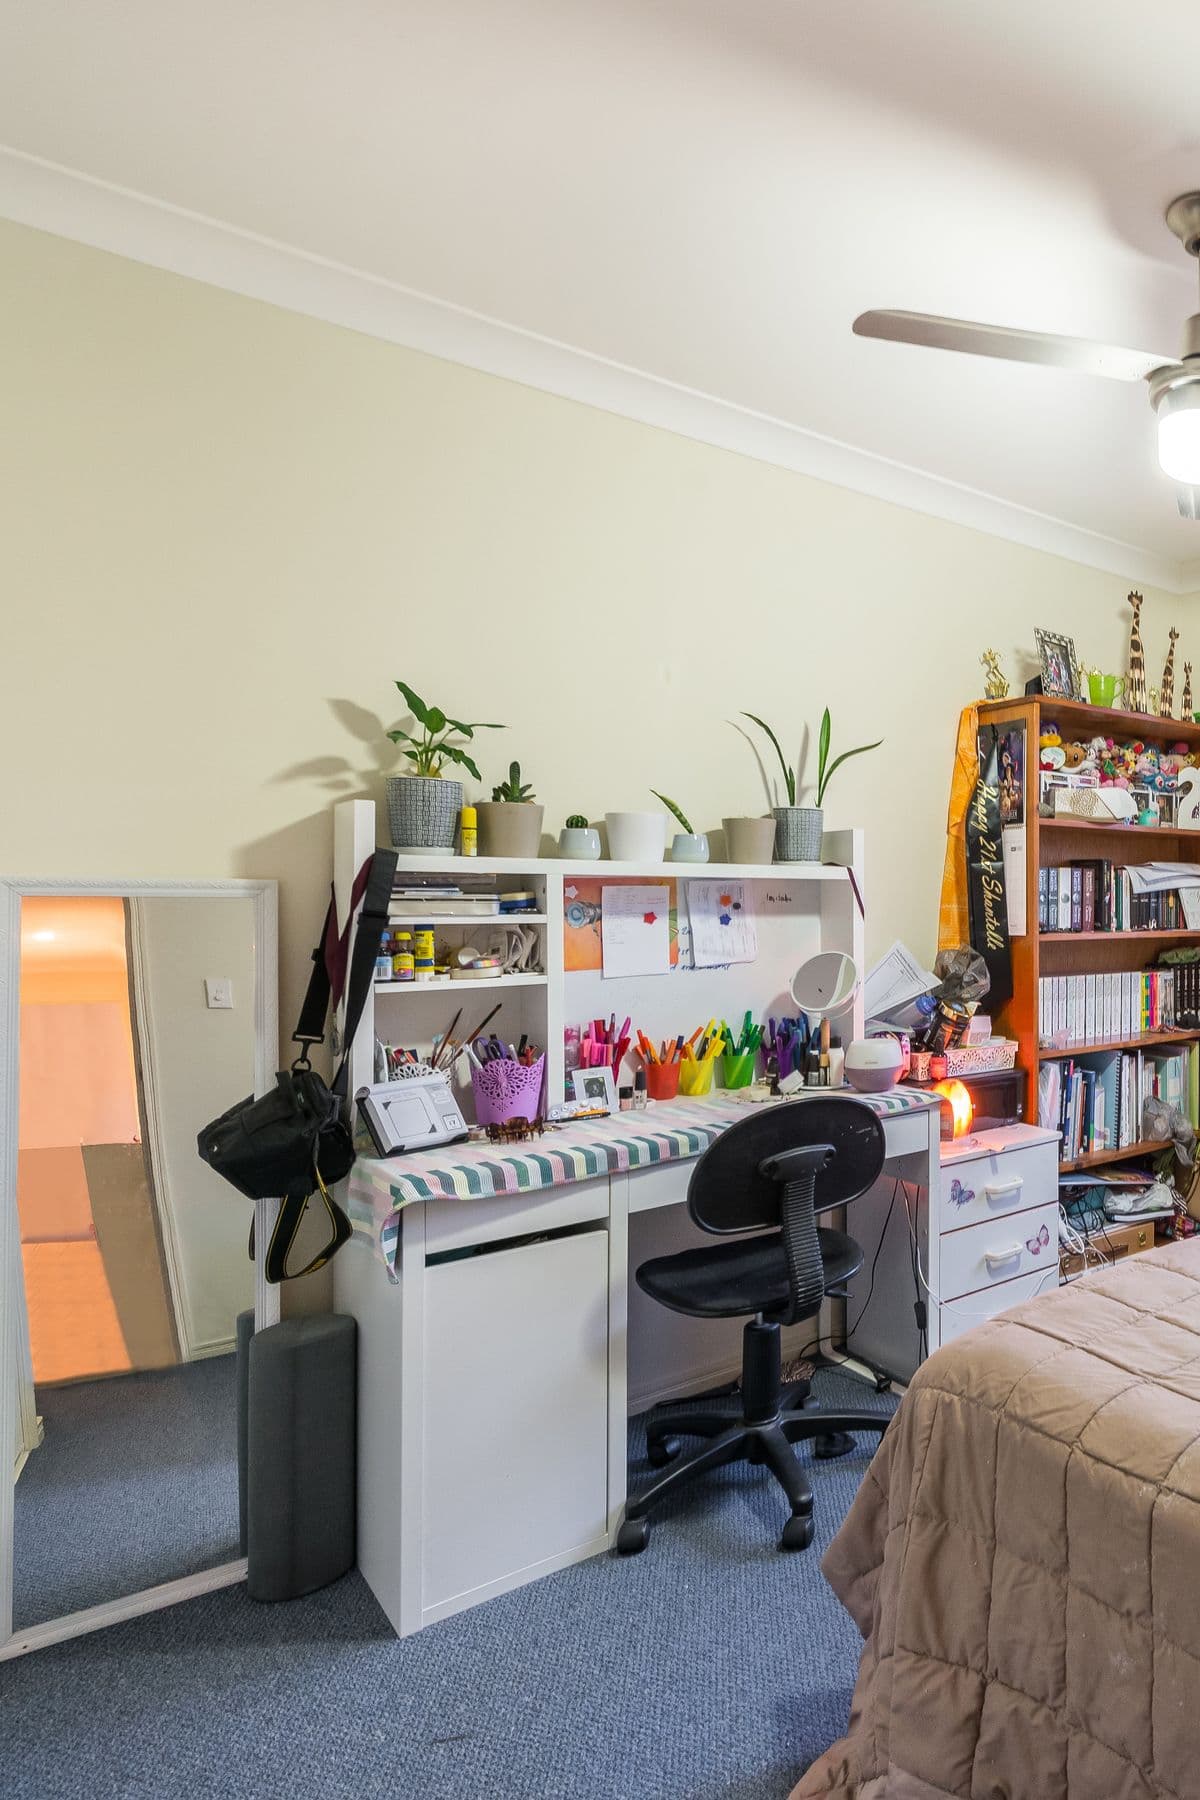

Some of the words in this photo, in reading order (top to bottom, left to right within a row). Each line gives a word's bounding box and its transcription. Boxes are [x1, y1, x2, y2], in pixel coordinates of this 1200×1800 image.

[971, 779, 999, 833] Happy
[980, 836, 996, 874] 21st
[982, 875, 1003, 951] Shantelle
